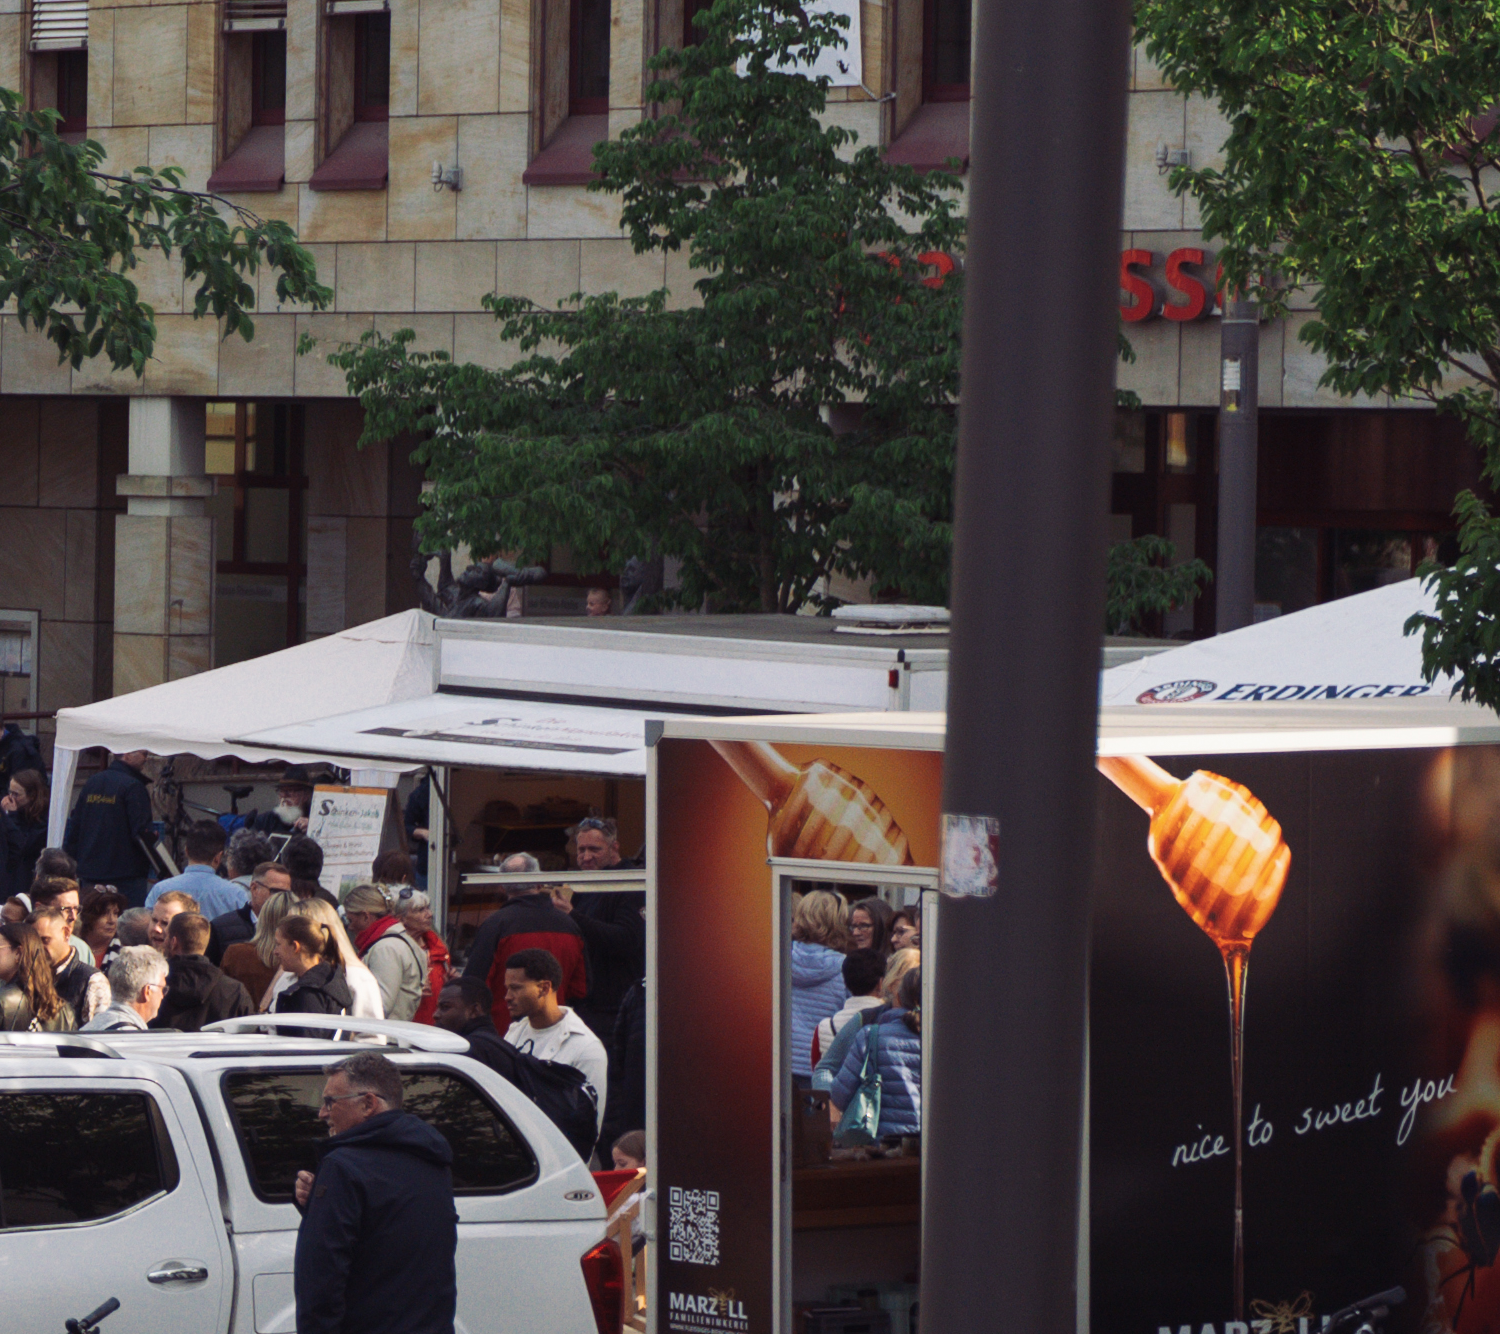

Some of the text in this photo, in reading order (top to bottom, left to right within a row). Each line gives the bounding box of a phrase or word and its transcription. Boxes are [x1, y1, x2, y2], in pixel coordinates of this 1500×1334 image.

[1214, 683, 1431, 700] ERDINGER
[1172, 1073, 1457, 1167] nice to sweet you
[669, 1311, 748, 1330] FAMILIENIMKEREI
